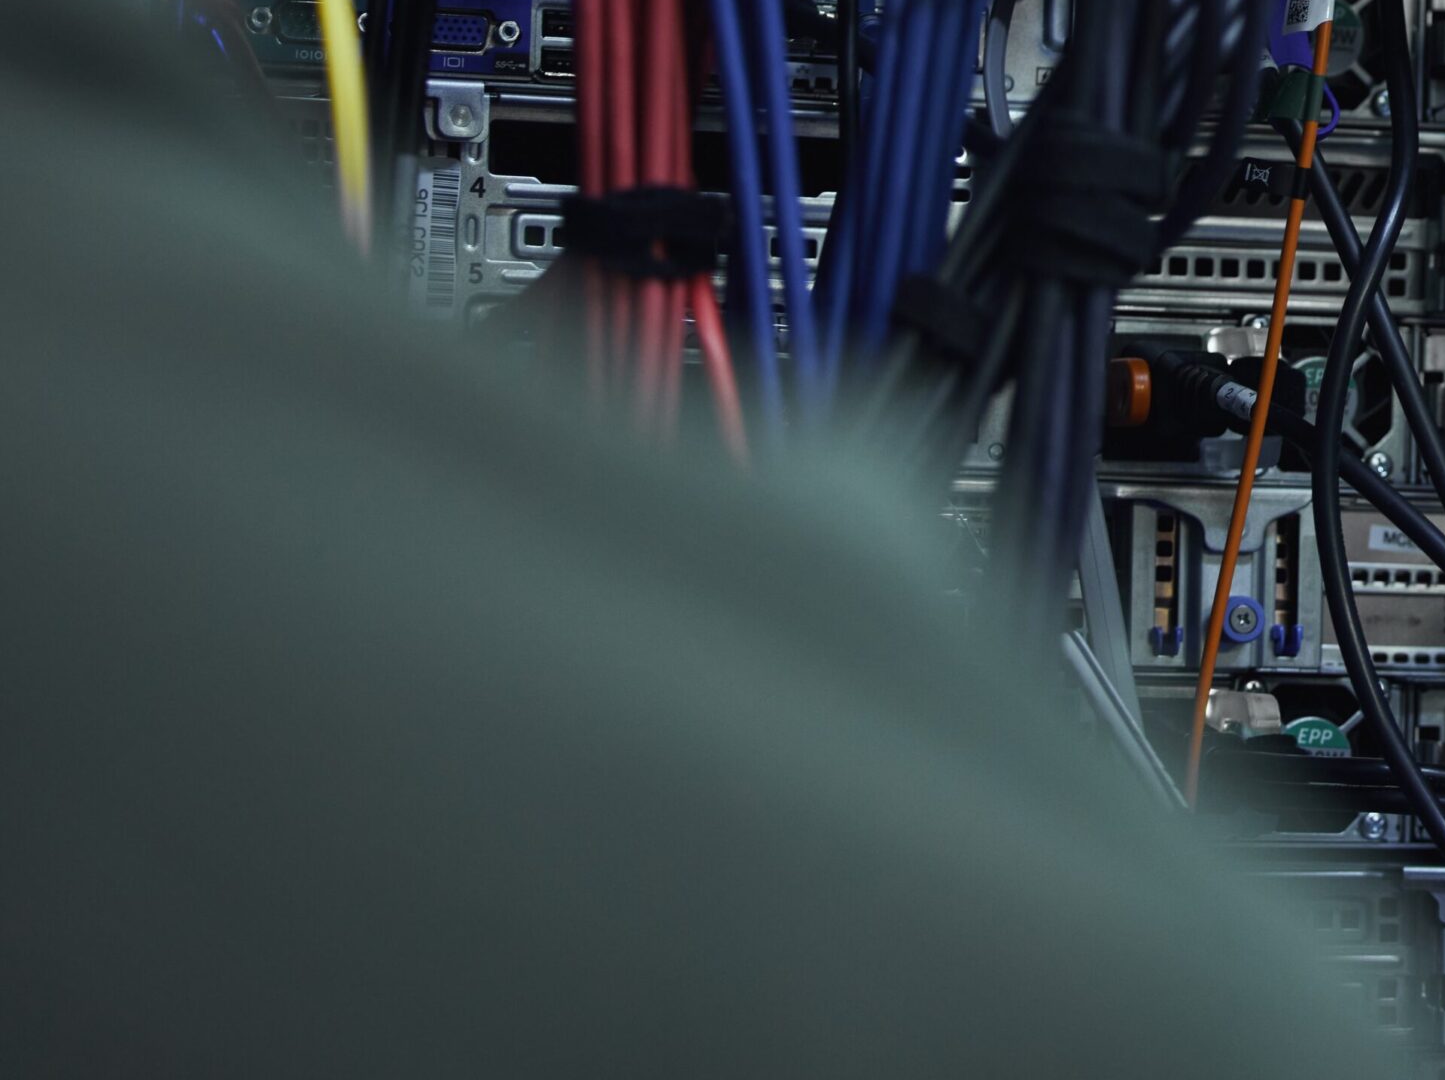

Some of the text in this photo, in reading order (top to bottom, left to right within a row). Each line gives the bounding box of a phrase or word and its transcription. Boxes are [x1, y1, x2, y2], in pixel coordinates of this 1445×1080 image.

[469, 176, 486, 199] 4
[468, 263, 484, 285] 5
[1296, 727, 1334, 745] EPP
